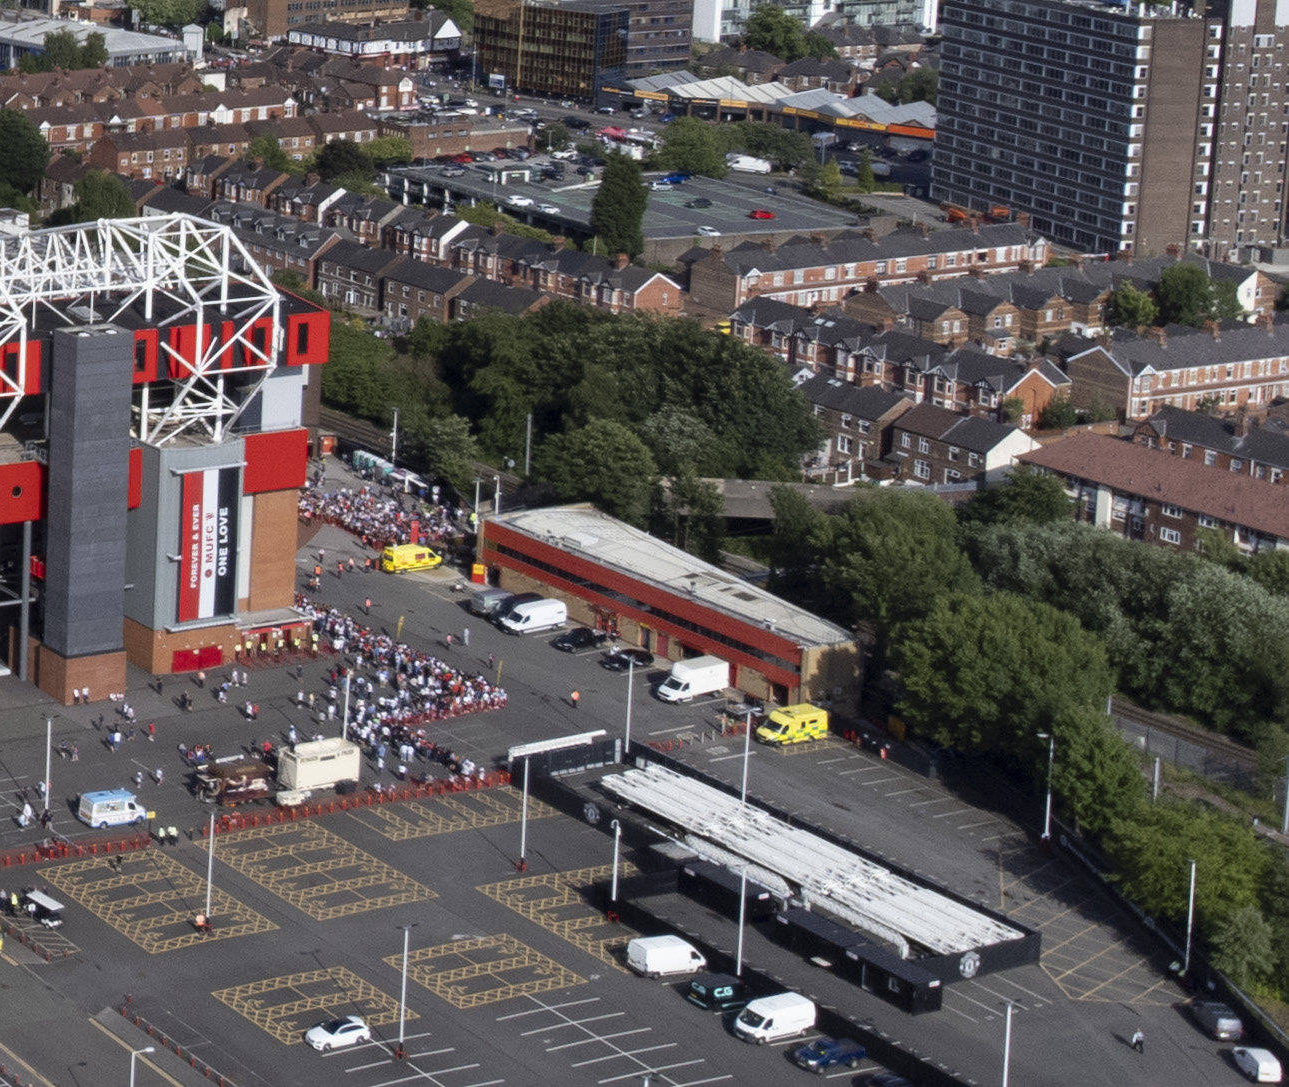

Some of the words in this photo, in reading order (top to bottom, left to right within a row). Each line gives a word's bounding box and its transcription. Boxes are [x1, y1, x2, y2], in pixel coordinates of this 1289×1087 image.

[192, 504, 200, 530] EVER
[219, 507, 229, 542] LOVE
[205, 524, 215, 564] MUFC
[189, 543, 200, 589] FOREVER
[217, 547, 228, 577] ONE
